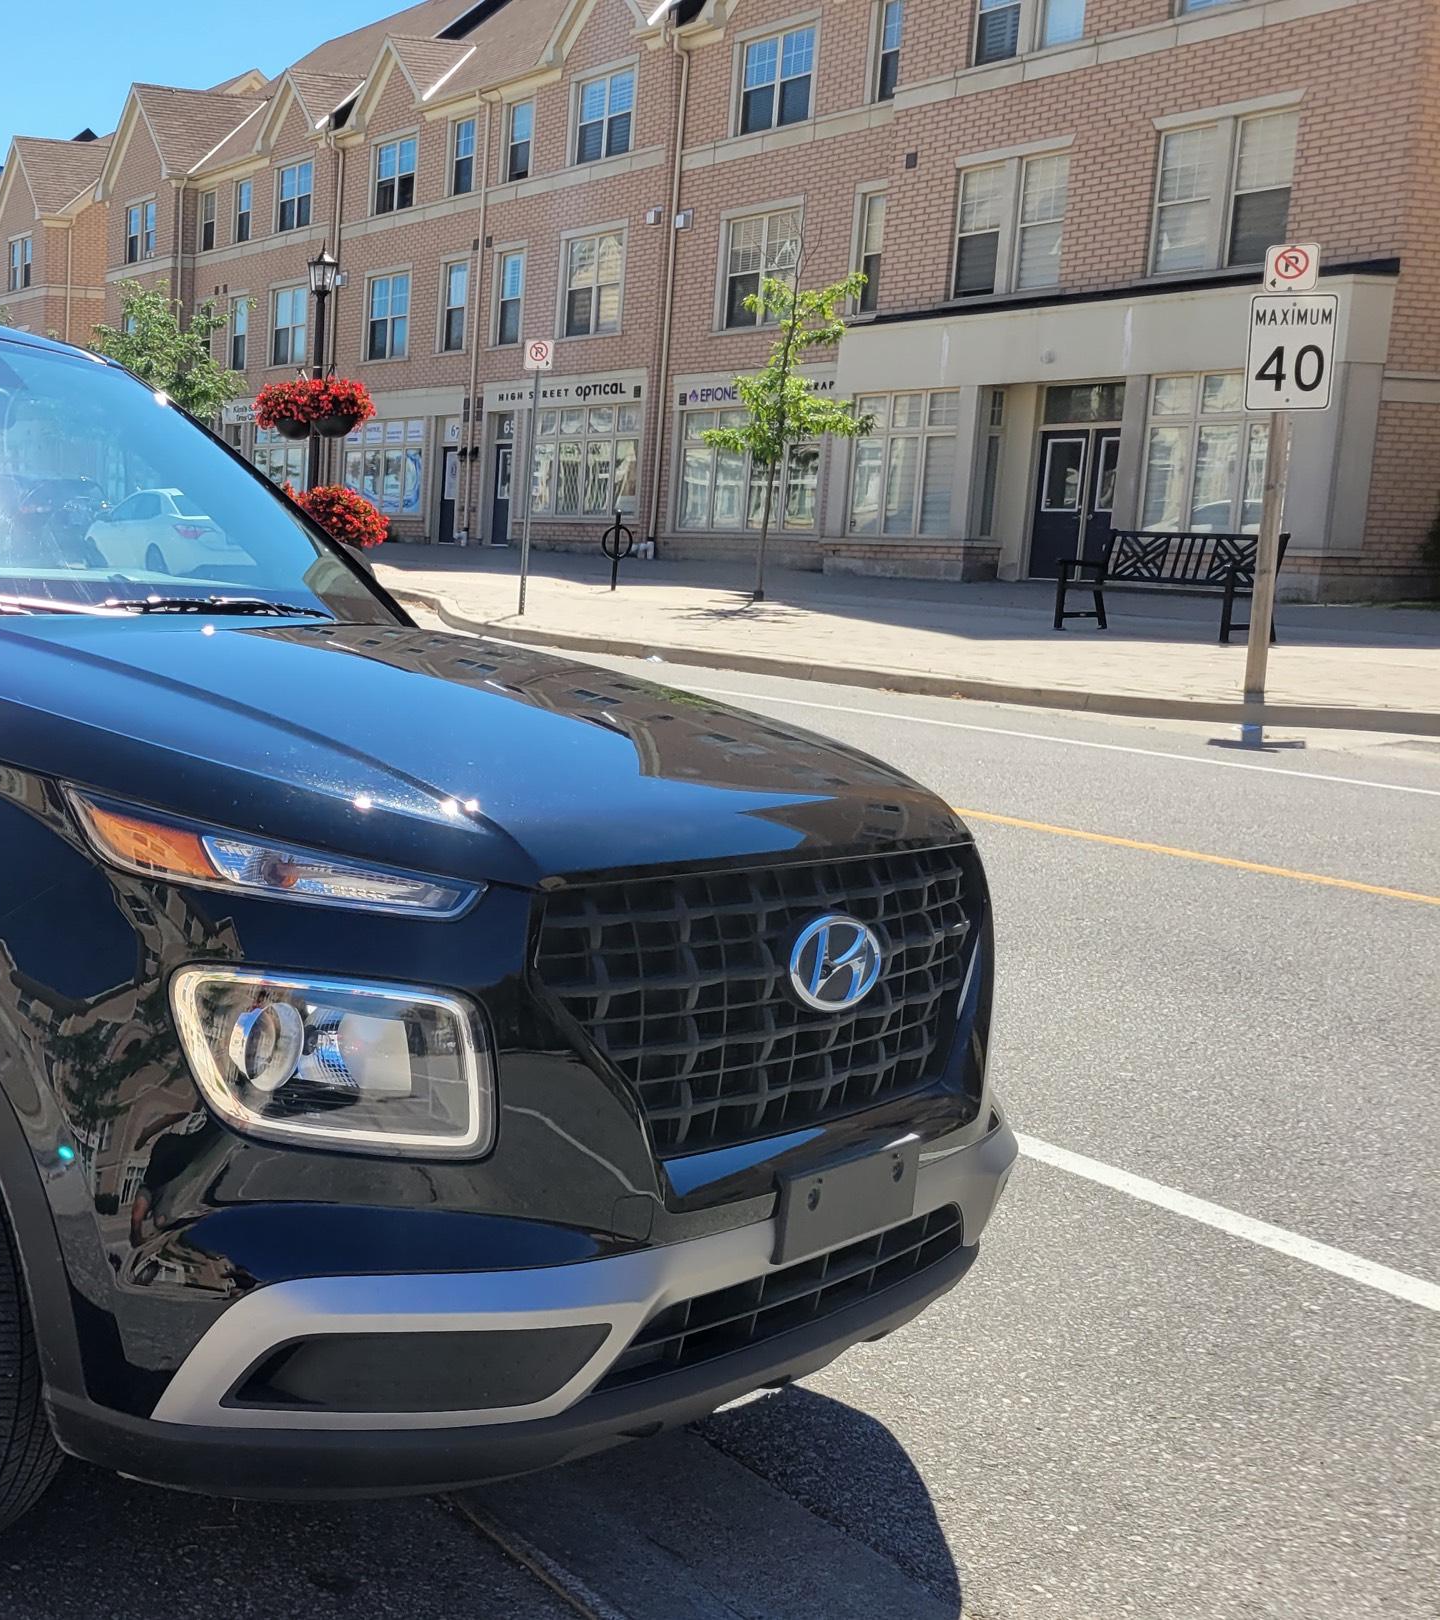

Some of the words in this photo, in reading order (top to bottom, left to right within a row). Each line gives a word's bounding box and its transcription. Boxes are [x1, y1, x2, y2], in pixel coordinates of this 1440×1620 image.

[1255, 308, 1333, 326] MAXIMUM
[1254, 344, 1325, 392] 40
[498, 391, 523, 401] HIGH
[528, 388, 569, 400] SREET
[700, 386, 738, 402] EPIONE
